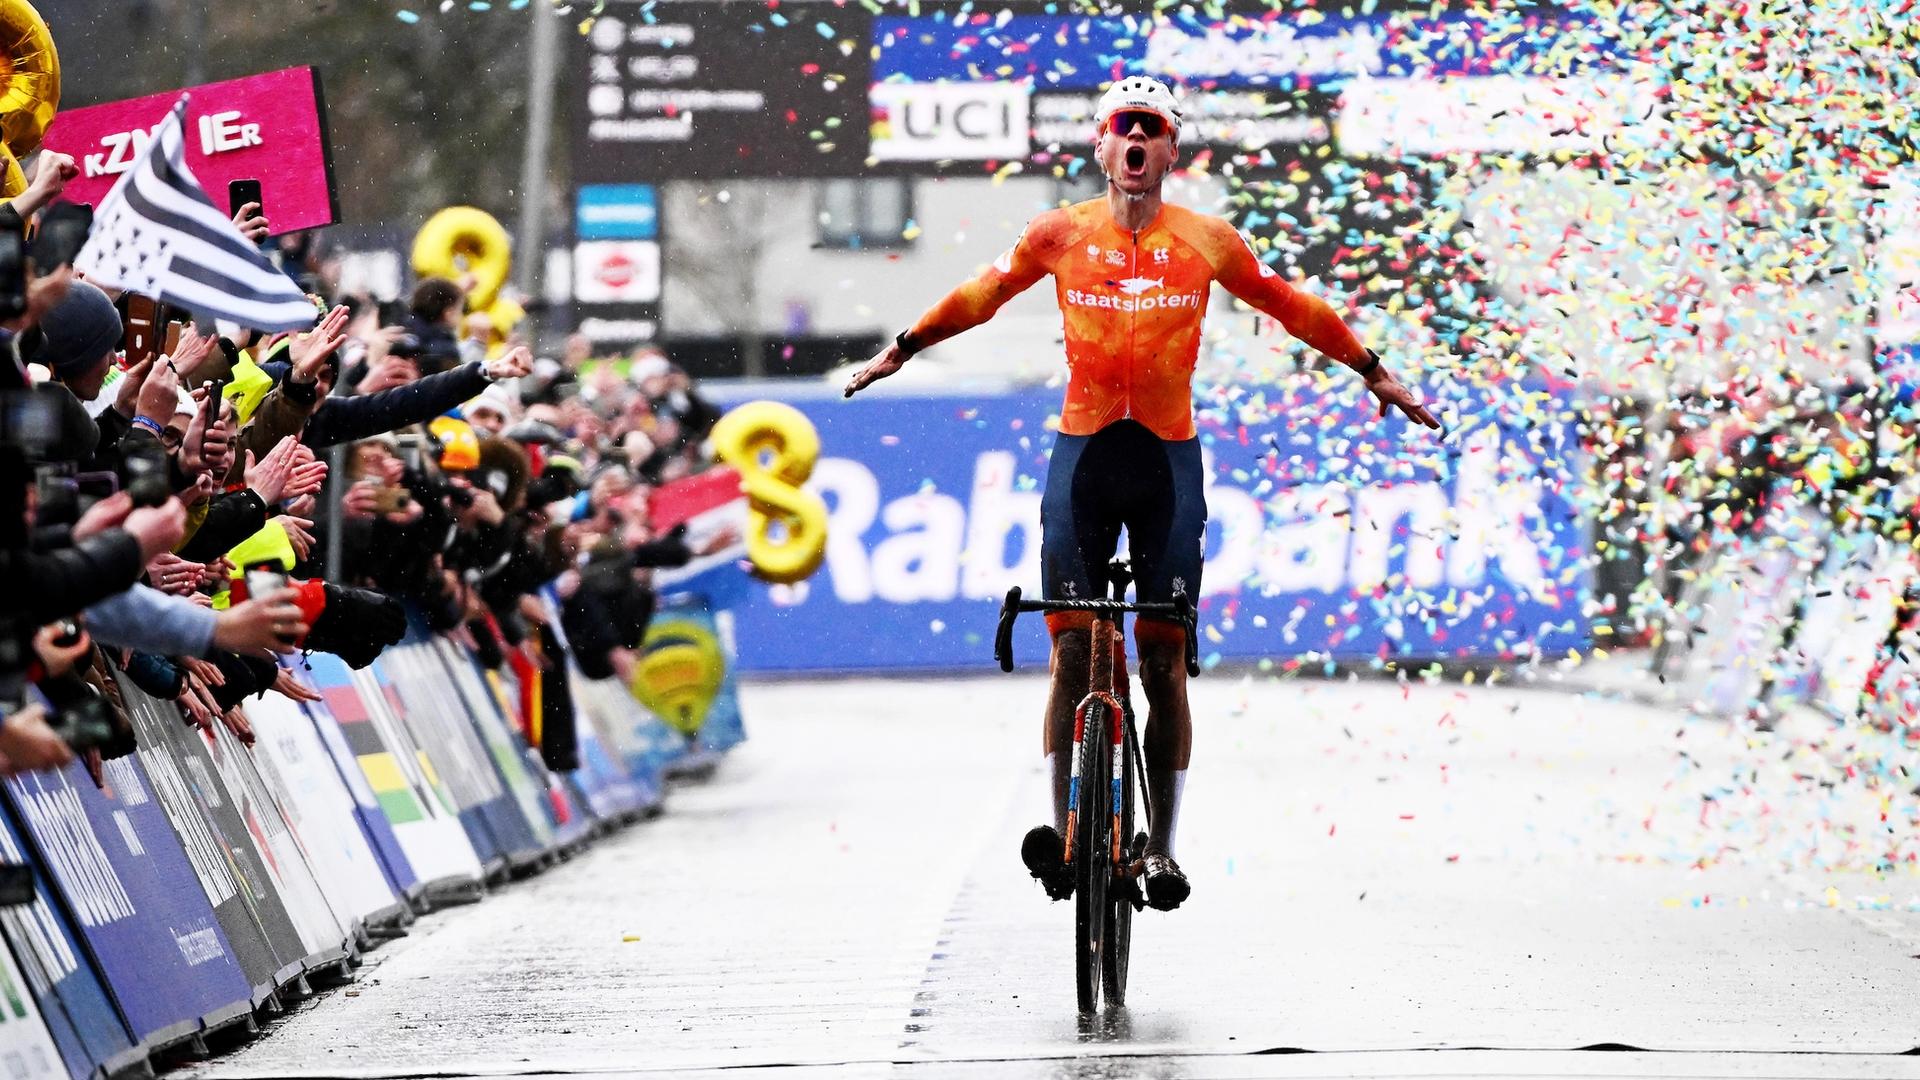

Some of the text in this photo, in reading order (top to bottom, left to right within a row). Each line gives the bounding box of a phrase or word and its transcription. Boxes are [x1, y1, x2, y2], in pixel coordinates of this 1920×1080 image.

[904, 100, 1009, 139] UCI
[1066, 288, 1201, 312] Staatsloterij
[781, 432, 1548, 607] Rabbank
